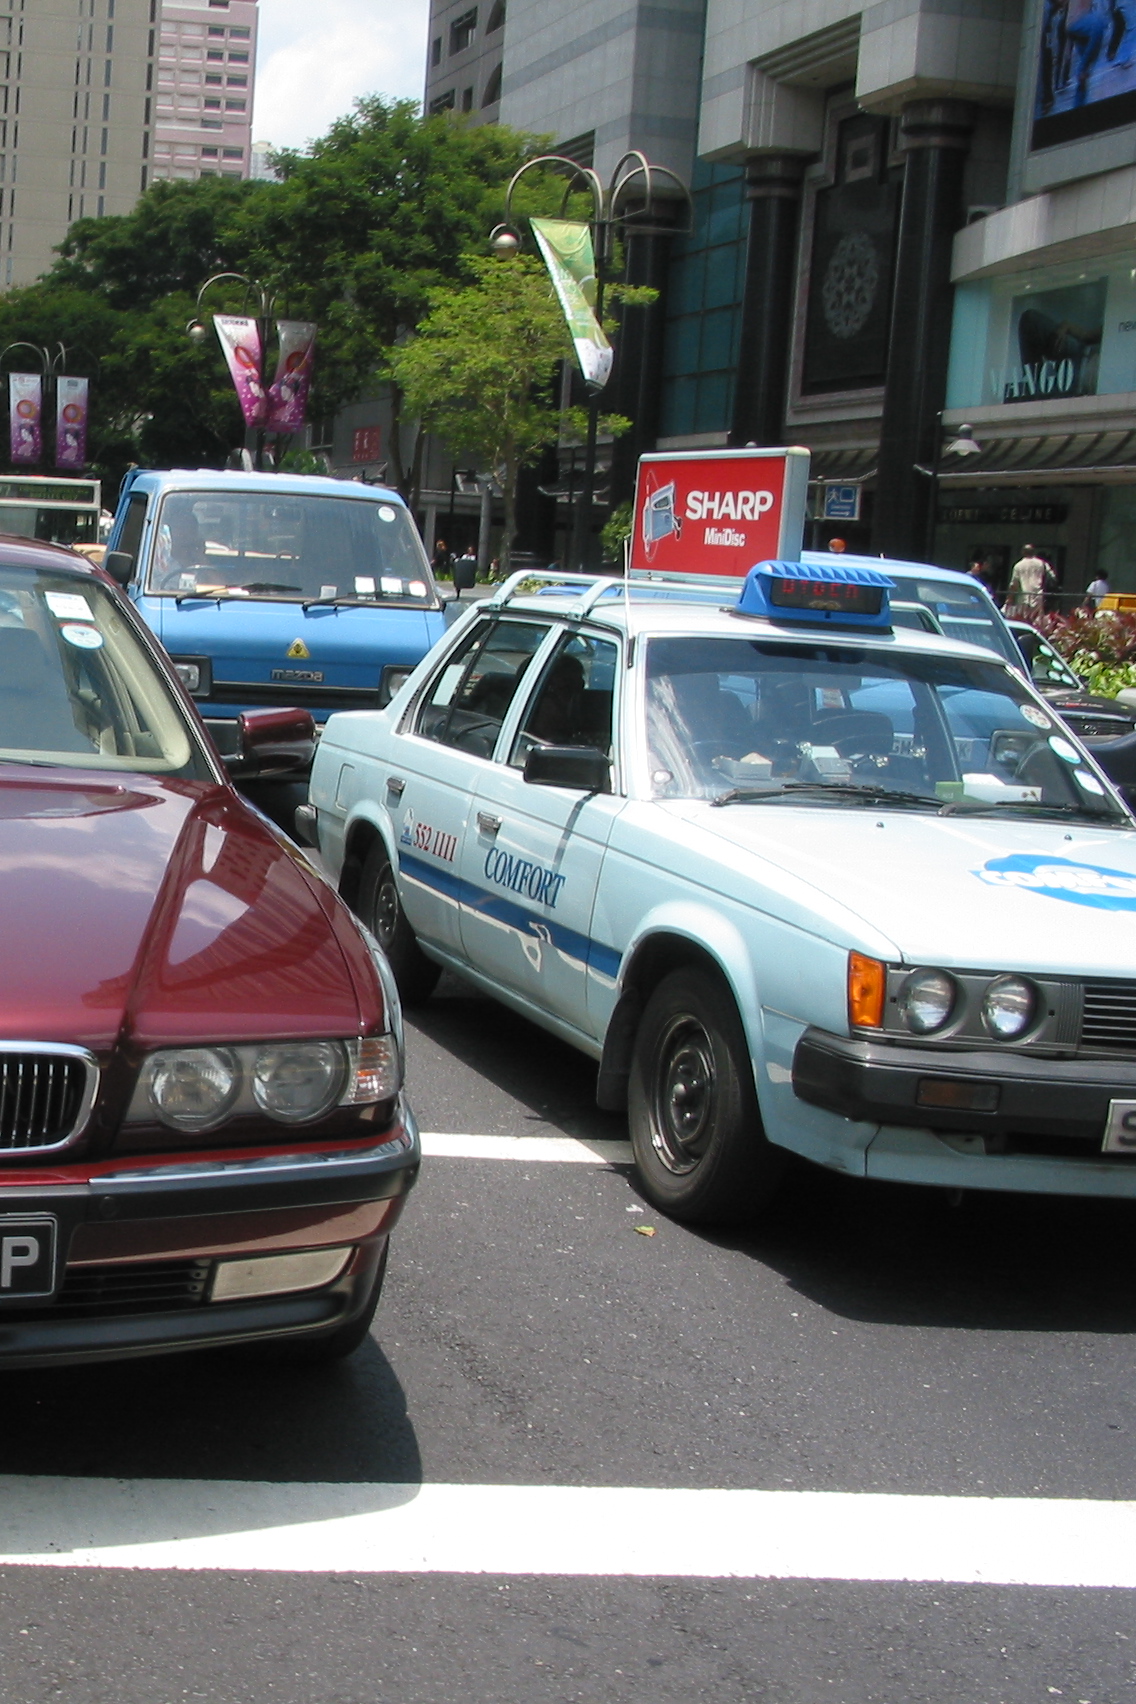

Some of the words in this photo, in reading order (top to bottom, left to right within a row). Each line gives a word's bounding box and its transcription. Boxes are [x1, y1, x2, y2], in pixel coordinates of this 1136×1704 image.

[990, 357, 1074, 398] MANGO
[685, 490, 774, 521] SHARP
[703, 527, 746, 547] MiniDisc
[413, 822, 433, 851] 552
[431, 830, 458, 863] 1111
[484, 846, 567, 909] COMFORT
[1, 1236, 39, 1288] P
